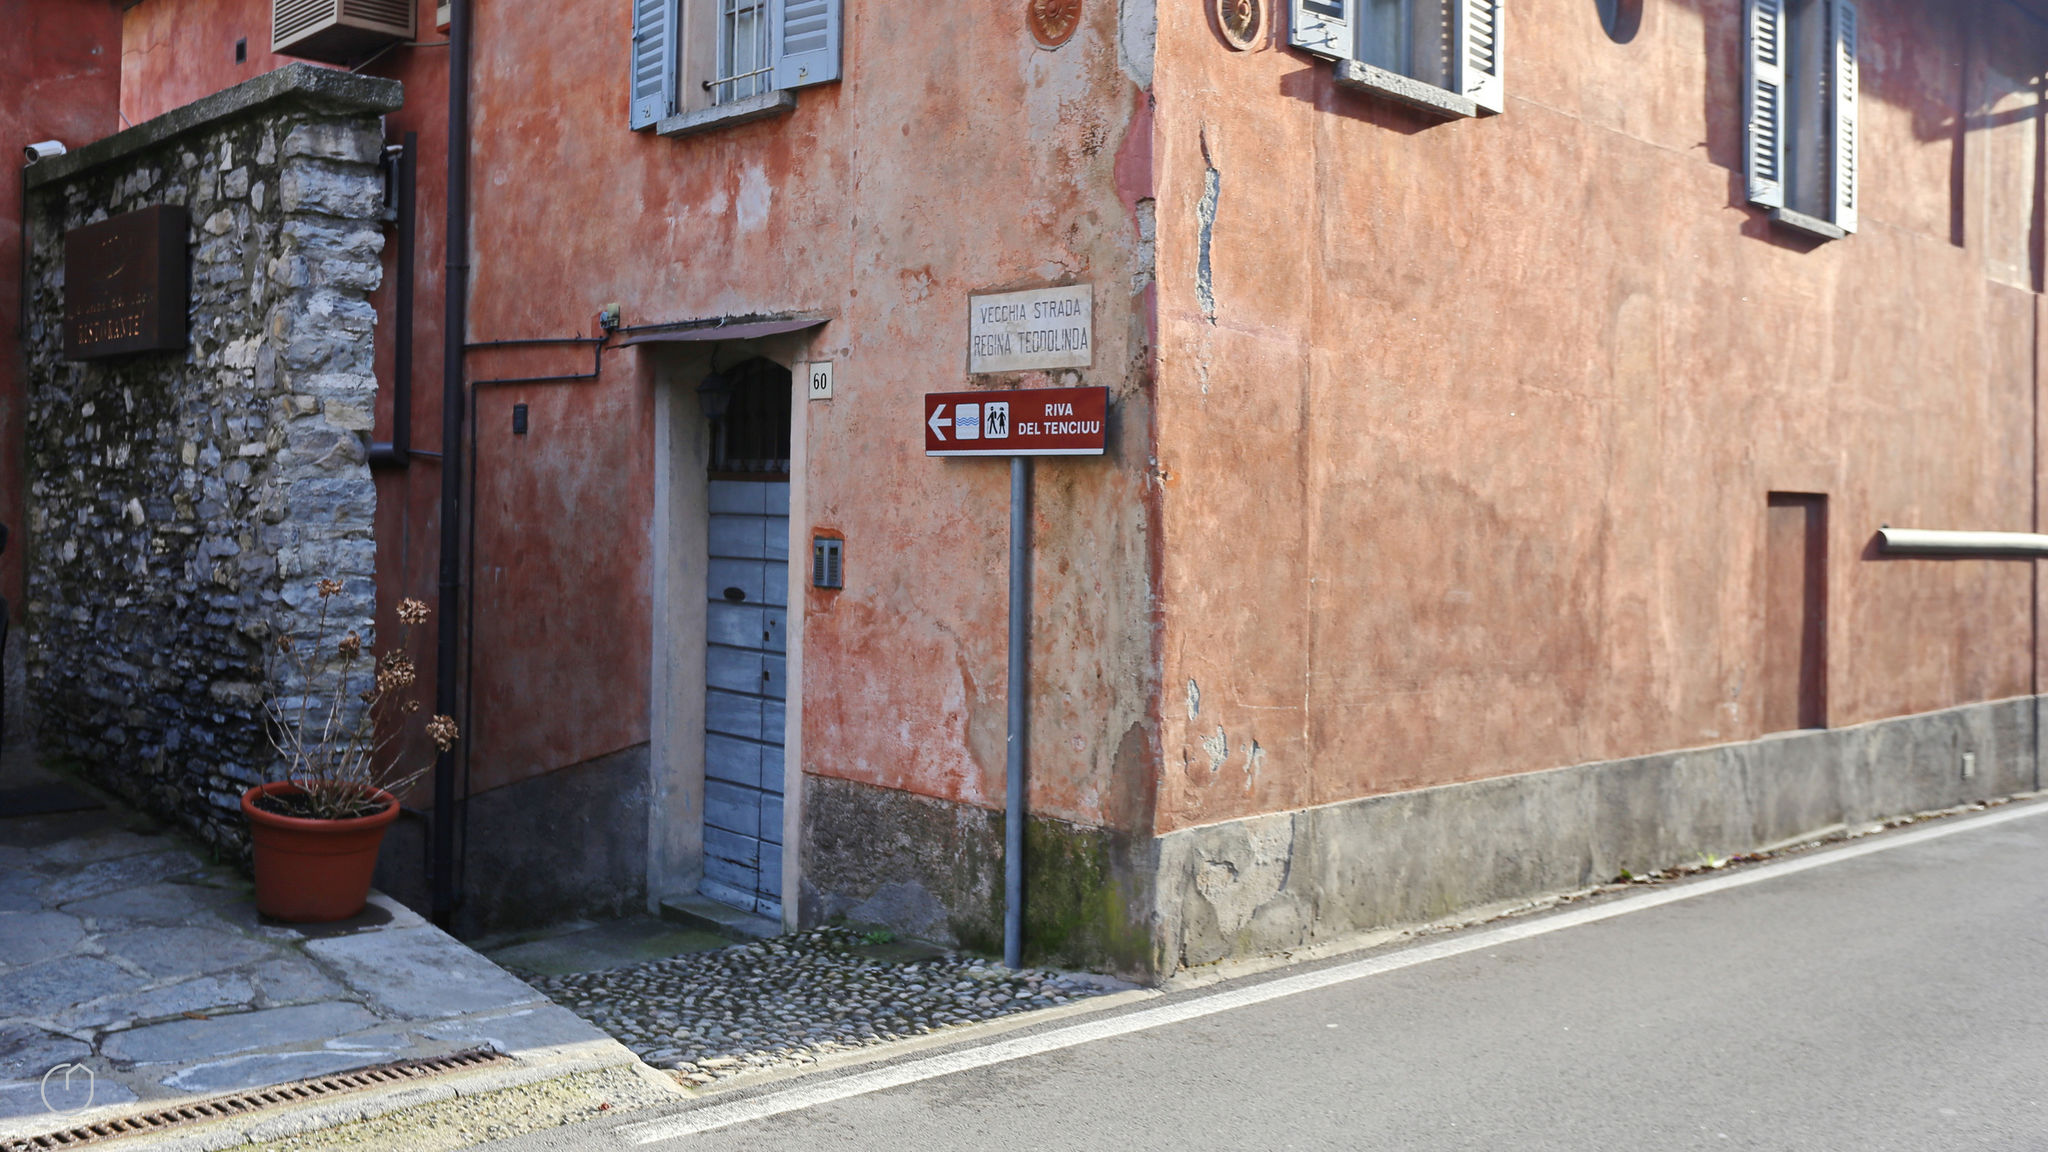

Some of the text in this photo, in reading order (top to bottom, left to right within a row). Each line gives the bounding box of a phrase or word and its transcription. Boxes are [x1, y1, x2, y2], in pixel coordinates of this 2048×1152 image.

[980, 299, 1081, 324] VECCHIA STRADA
[974, 327, 1089, 357] REGINA TEODOLINDA
[813, 372, 827, 390] 60
[1045, 403, 1073, 416] RIVA
[1018, 420, 1100, 435] DEL TENCIUU
